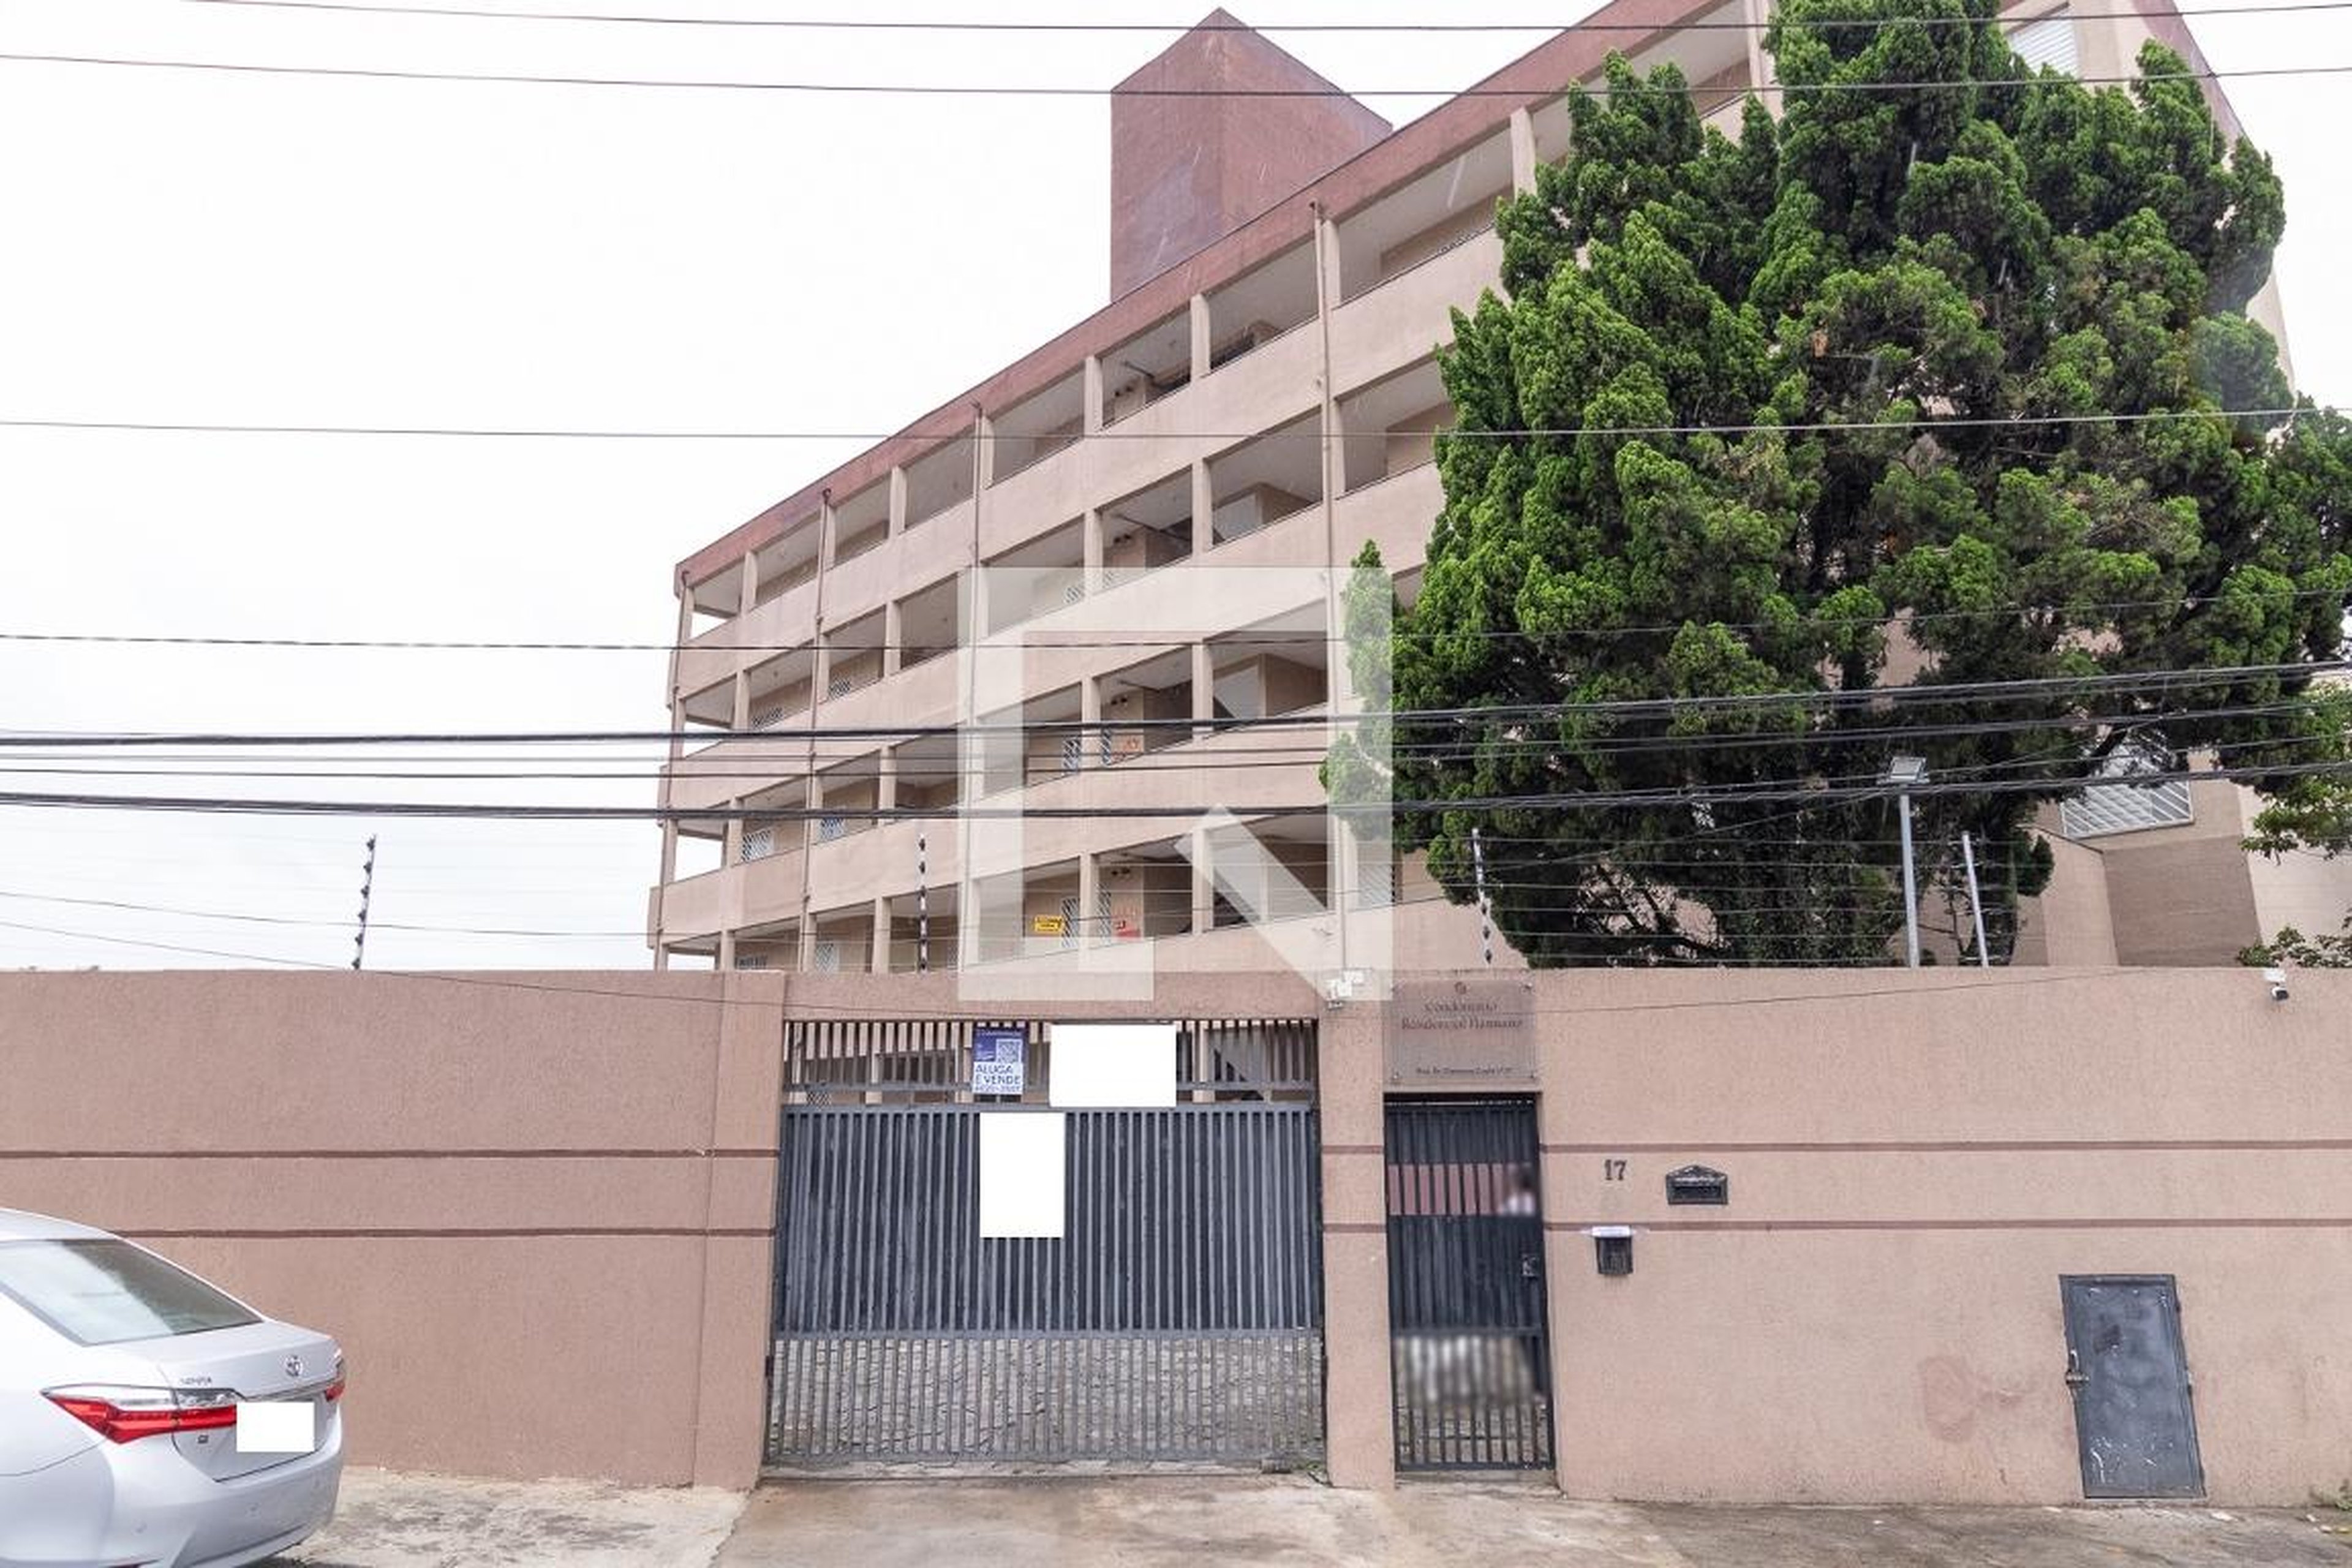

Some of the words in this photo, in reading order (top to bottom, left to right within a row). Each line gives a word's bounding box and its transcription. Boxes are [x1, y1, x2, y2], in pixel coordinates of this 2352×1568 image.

[975, 1064, 1013, 1074] ALUGA
[976, 1073, 981, 1084] E
[983, 1075, 1021, 1085] VENDE
[1604, 1159, 1627, 1181] 17
